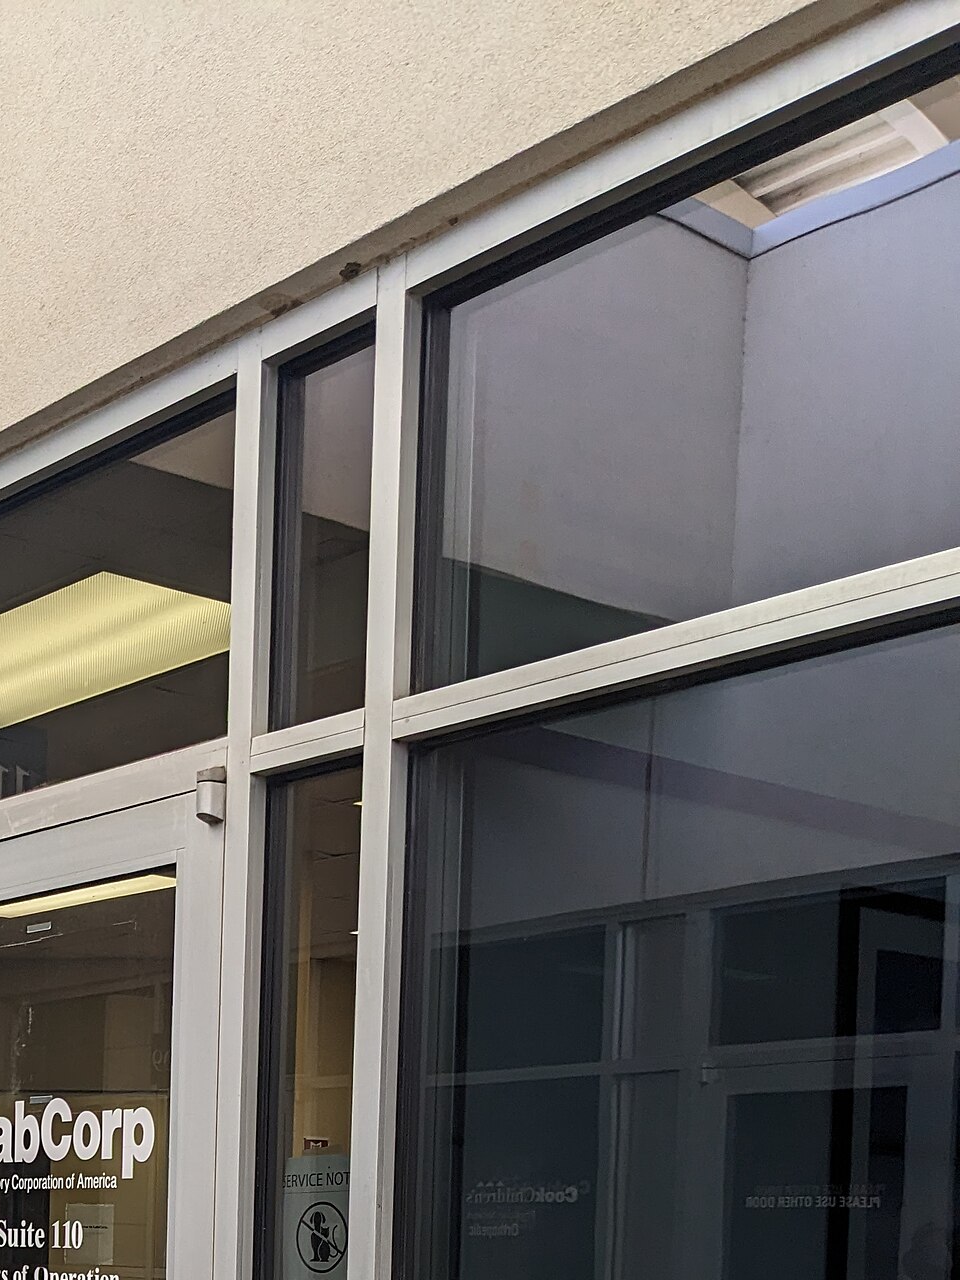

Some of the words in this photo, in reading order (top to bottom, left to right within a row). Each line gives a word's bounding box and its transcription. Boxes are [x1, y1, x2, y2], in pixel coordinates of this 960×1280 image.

[11, 1173, 64, 1194] Corporation
[65, 1172, 75, 1189] of
[77, 1173, 118, 1189] America
[282, 1172, 323, 1189] SERVICE
[326, 1171, 350, 1186] NOT
[51, 1220, 84, 1249] 110
